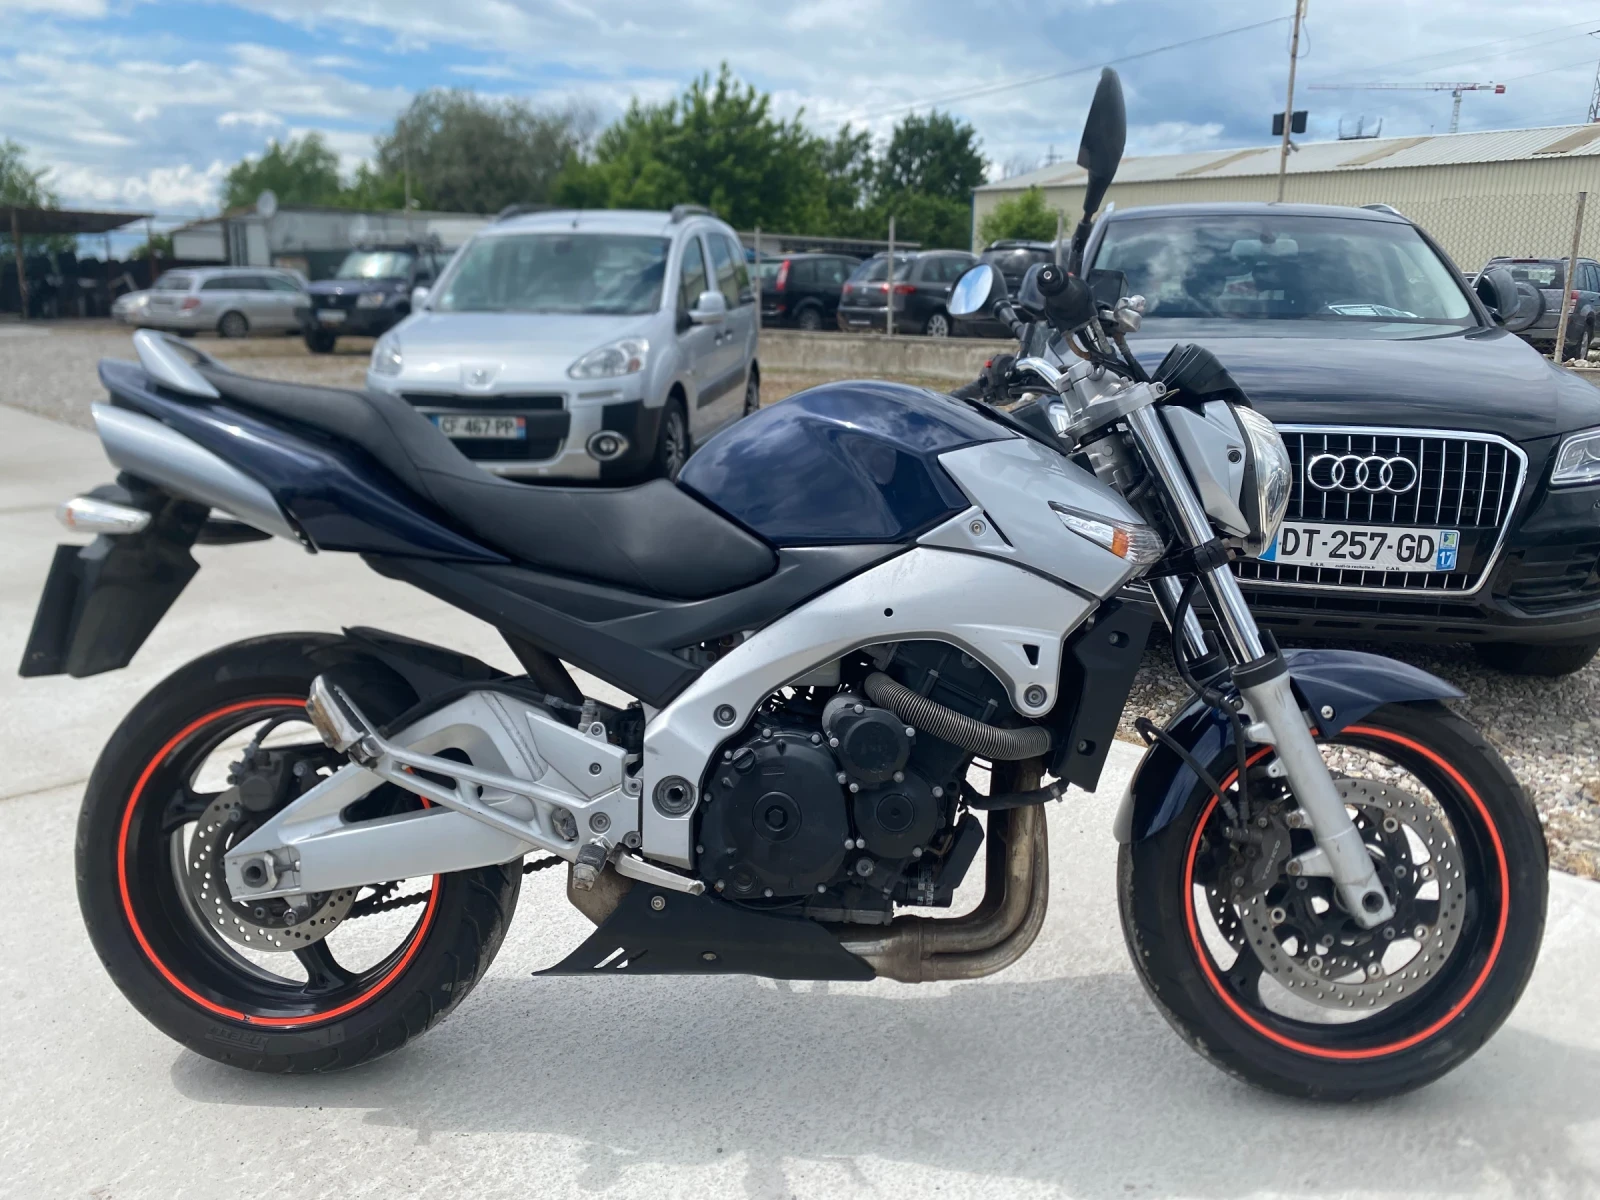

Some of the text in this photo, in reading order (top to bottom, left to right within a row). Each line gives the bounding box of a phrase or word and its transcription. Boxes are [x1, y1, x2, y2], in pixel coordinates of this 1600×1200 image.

[1281, 527, 1436, 564] DT-257-GD
[1439, 551, 1453, 566] 17
[1262, 840, 1281, 881] TOKICO
